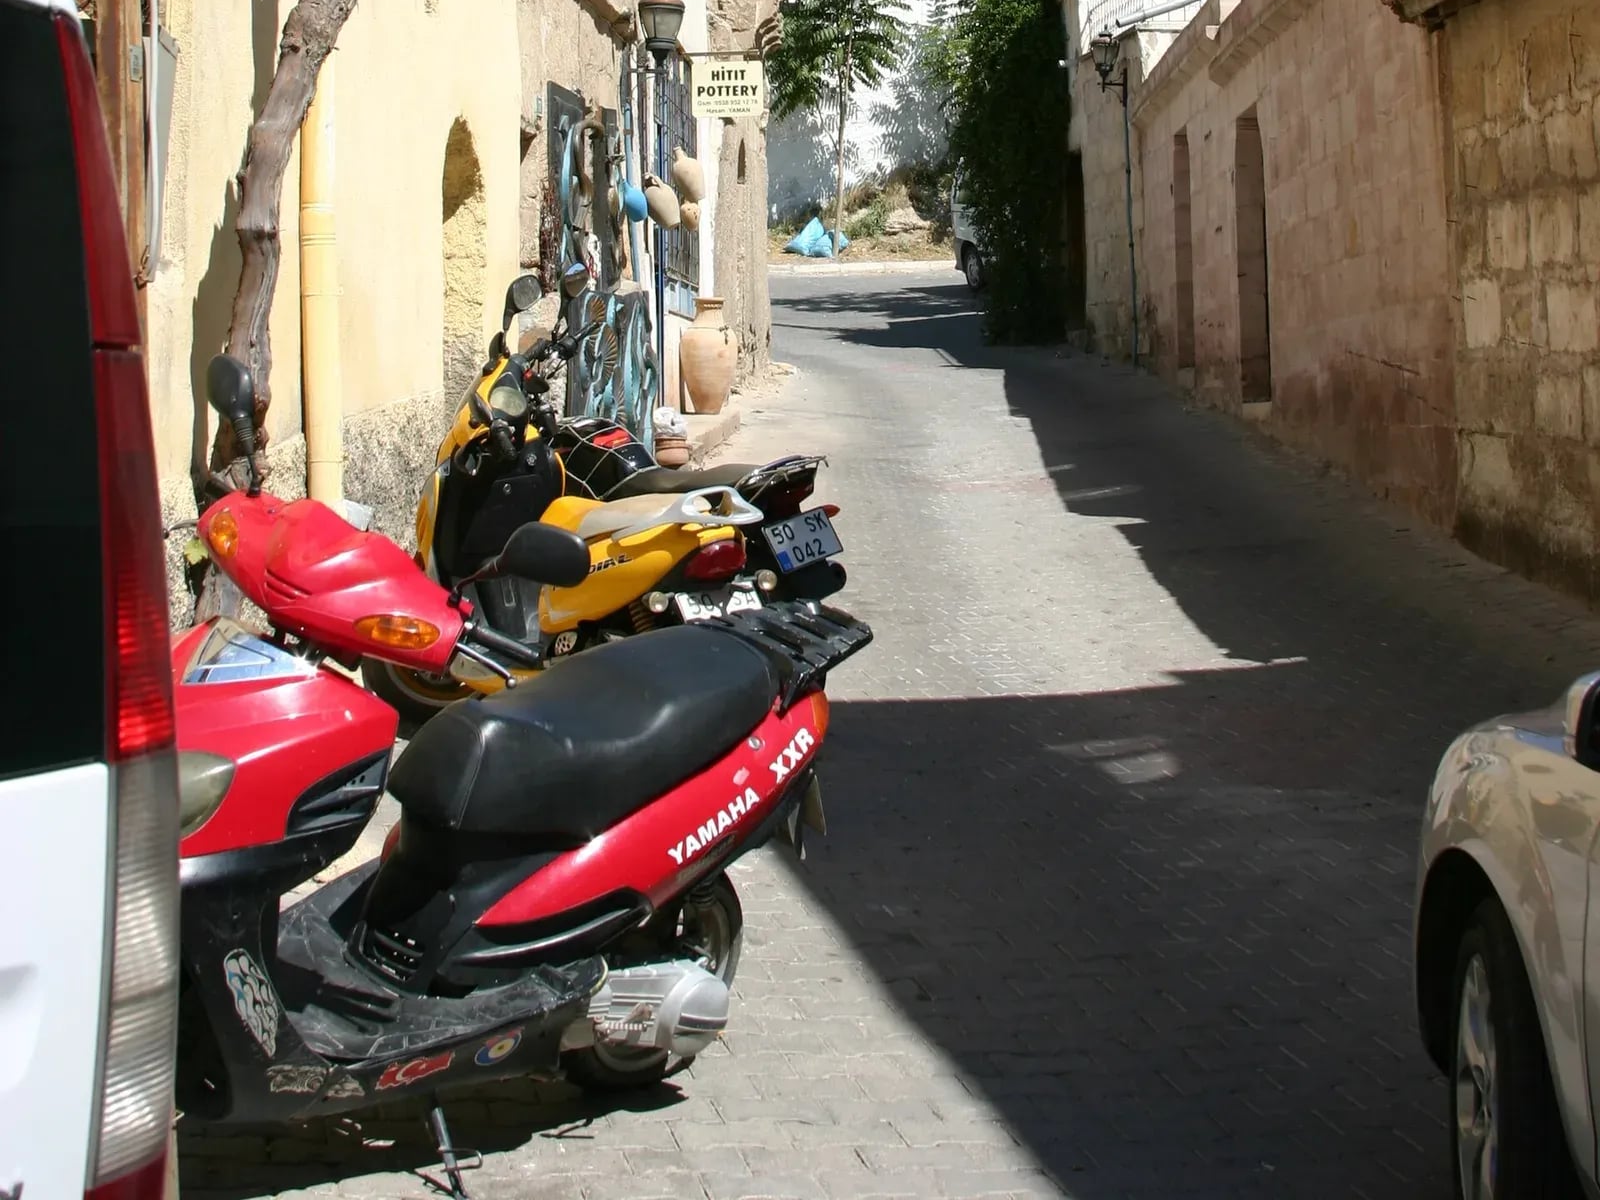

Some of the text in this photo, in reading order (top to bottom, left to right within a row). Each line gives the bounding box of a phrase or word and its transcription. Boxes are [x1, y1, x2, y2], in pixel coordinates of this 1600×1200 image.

[697, 85, 758, 97] POTTERY
[771, 511, 828, 544] 50 SK
[792, 538, 826, 562] 042
[687, 593, 714, 615] 50
[667, 727, 815, 865] YAMAHA XXR
